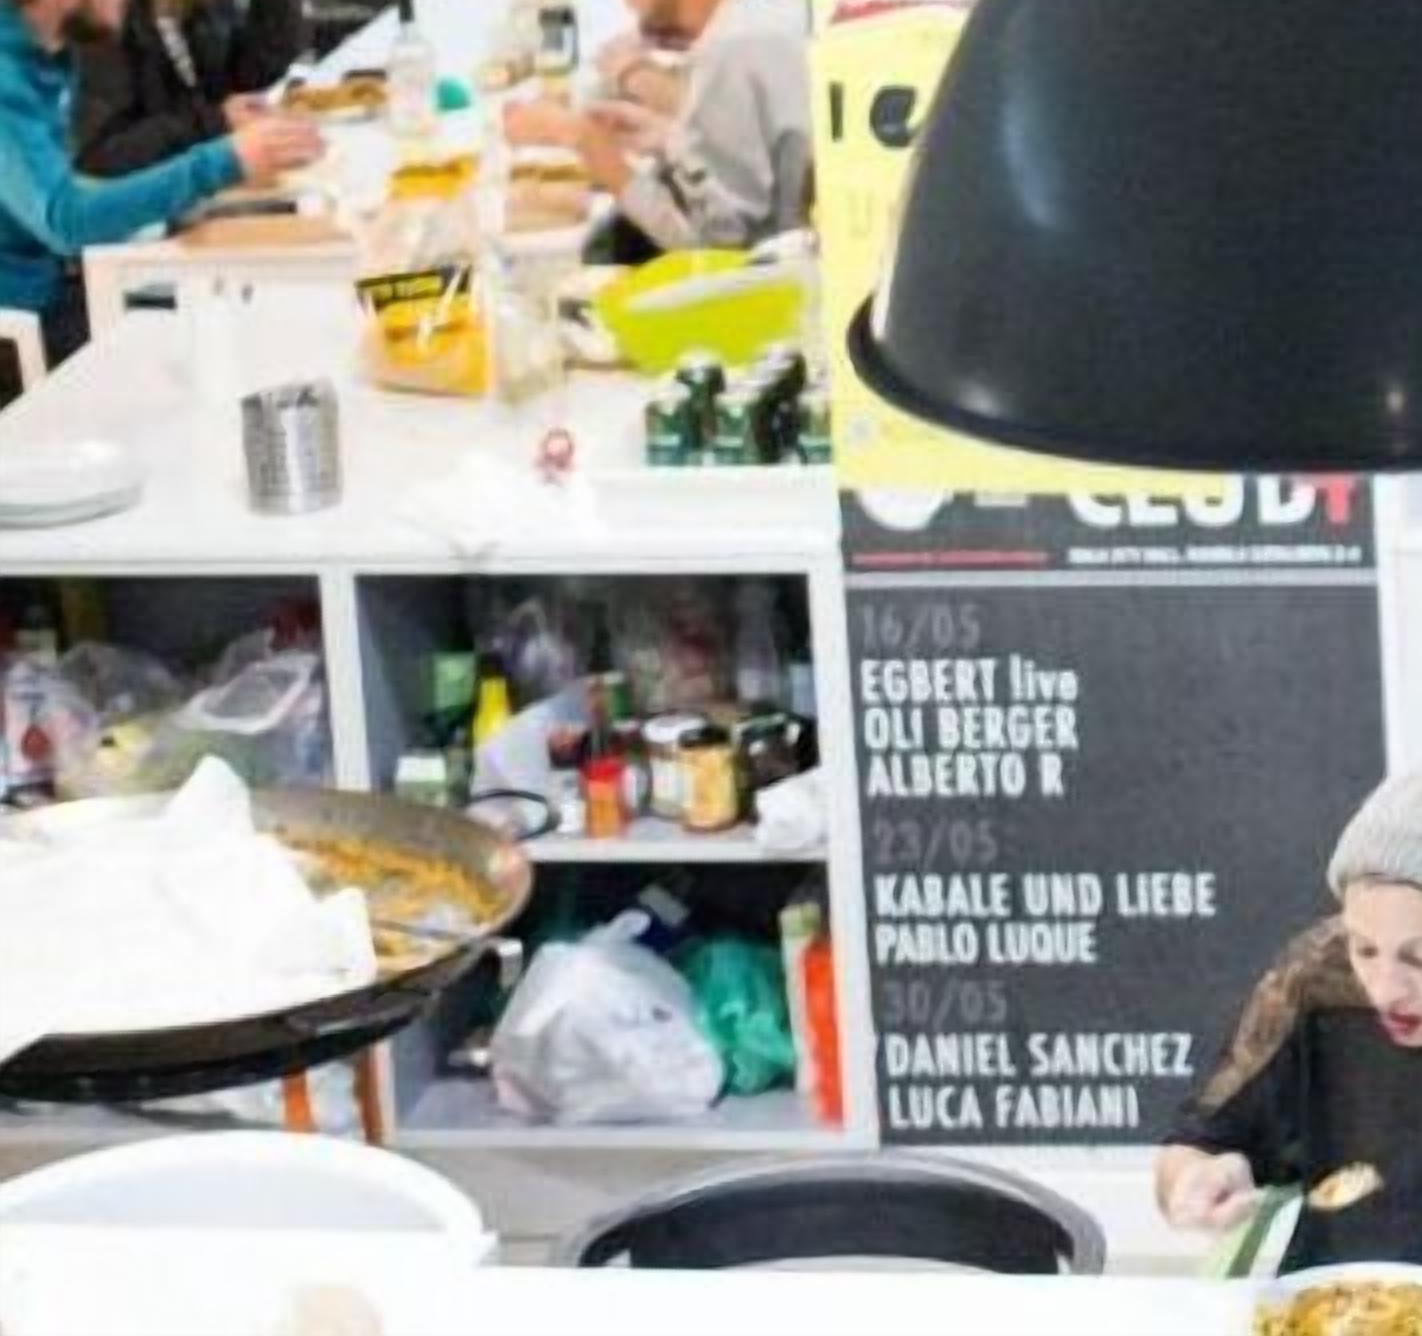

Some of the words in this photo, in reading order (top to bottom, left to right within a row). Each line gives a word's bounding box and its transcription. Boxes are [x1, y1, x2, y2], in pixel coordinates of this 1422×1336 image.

[862, 604, 981, 649] 16/05
[861, 658, 998, 702] EGBERT
[864, 707, 924, 750] OLI
[937, 705, 1079, 750] BERGER
[866, 752, 1026, 798] ALBERTO
[1040, 753, 1065, 797] R
[874, 820, 998, 868] 23/05
[874, 872, 1012, 916] KABALE
[1023, 871, 1102, 916] UND
[1116, 871, 1217, 916] LIEBE
[875, 923, 979, 964] PABLO
[987, 922, 1098, 964] LUQUE
[882, 979, 1008, 1026] 30/05
[885, 1032, 1017, 1077] DANIEL
[1027, 1032, 1195, 1077] SANCHEZ
[889, 1084, 984, 1128] LUCA
[996, 1084, 1140, 1128] FABIANI
